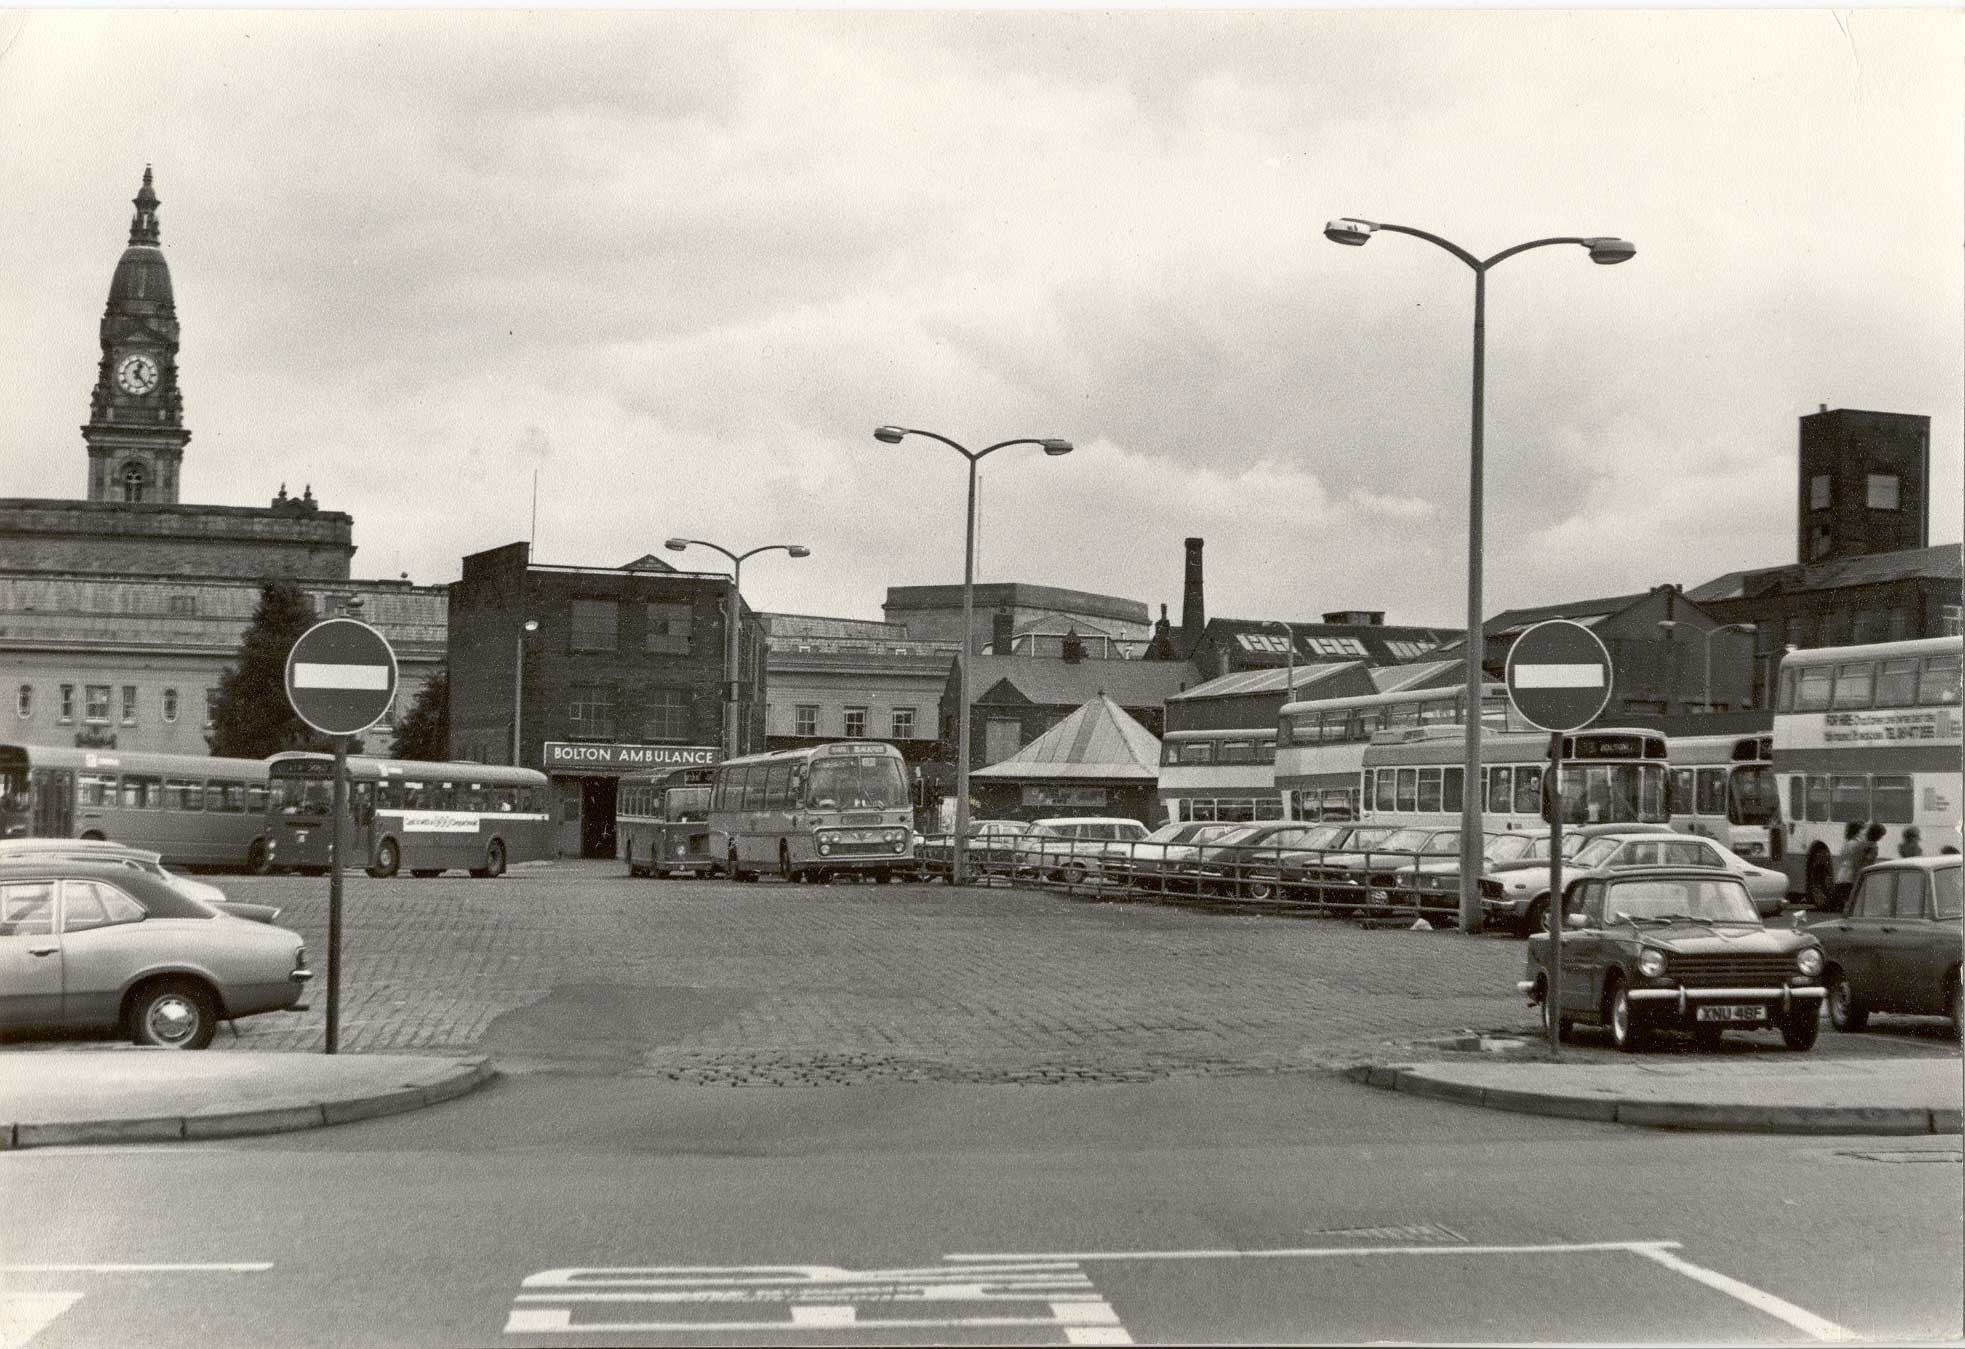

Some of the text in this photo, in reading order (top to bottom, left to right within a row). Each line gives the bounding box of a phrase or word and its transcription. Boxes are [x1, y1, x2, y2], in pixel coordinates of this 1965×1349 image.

[553, 747, 714, 764] BOLTON AMBULANCE
[1703, 1006, 1732, 1020] XNU
